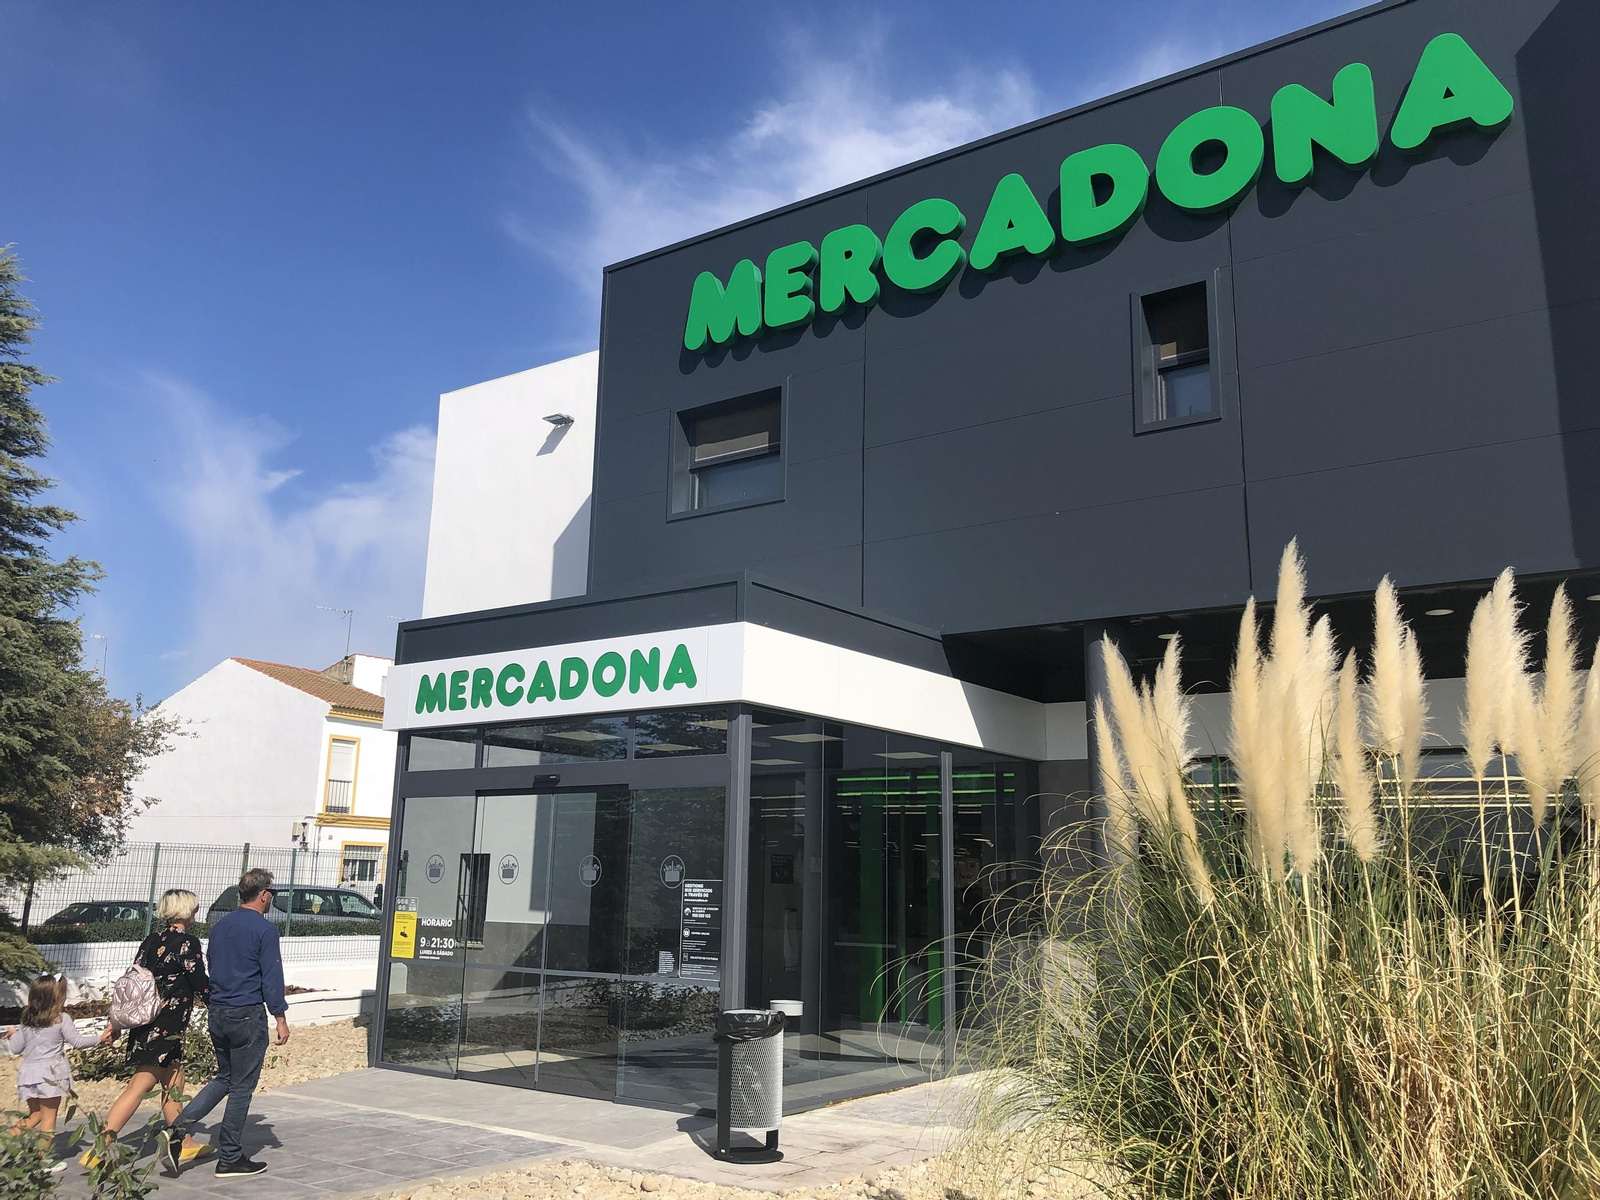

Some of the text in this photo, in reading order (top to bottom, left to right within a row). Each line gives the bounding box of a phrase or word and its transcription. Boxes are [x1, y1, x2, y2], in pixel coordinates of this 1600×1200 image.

[683, 32, 1515, 352] MERCADONA
[415, 643, 697, 714] MERCADONA
[420, 937, 426, 947] 9
[421, 919, 453, 927] HORARIO
